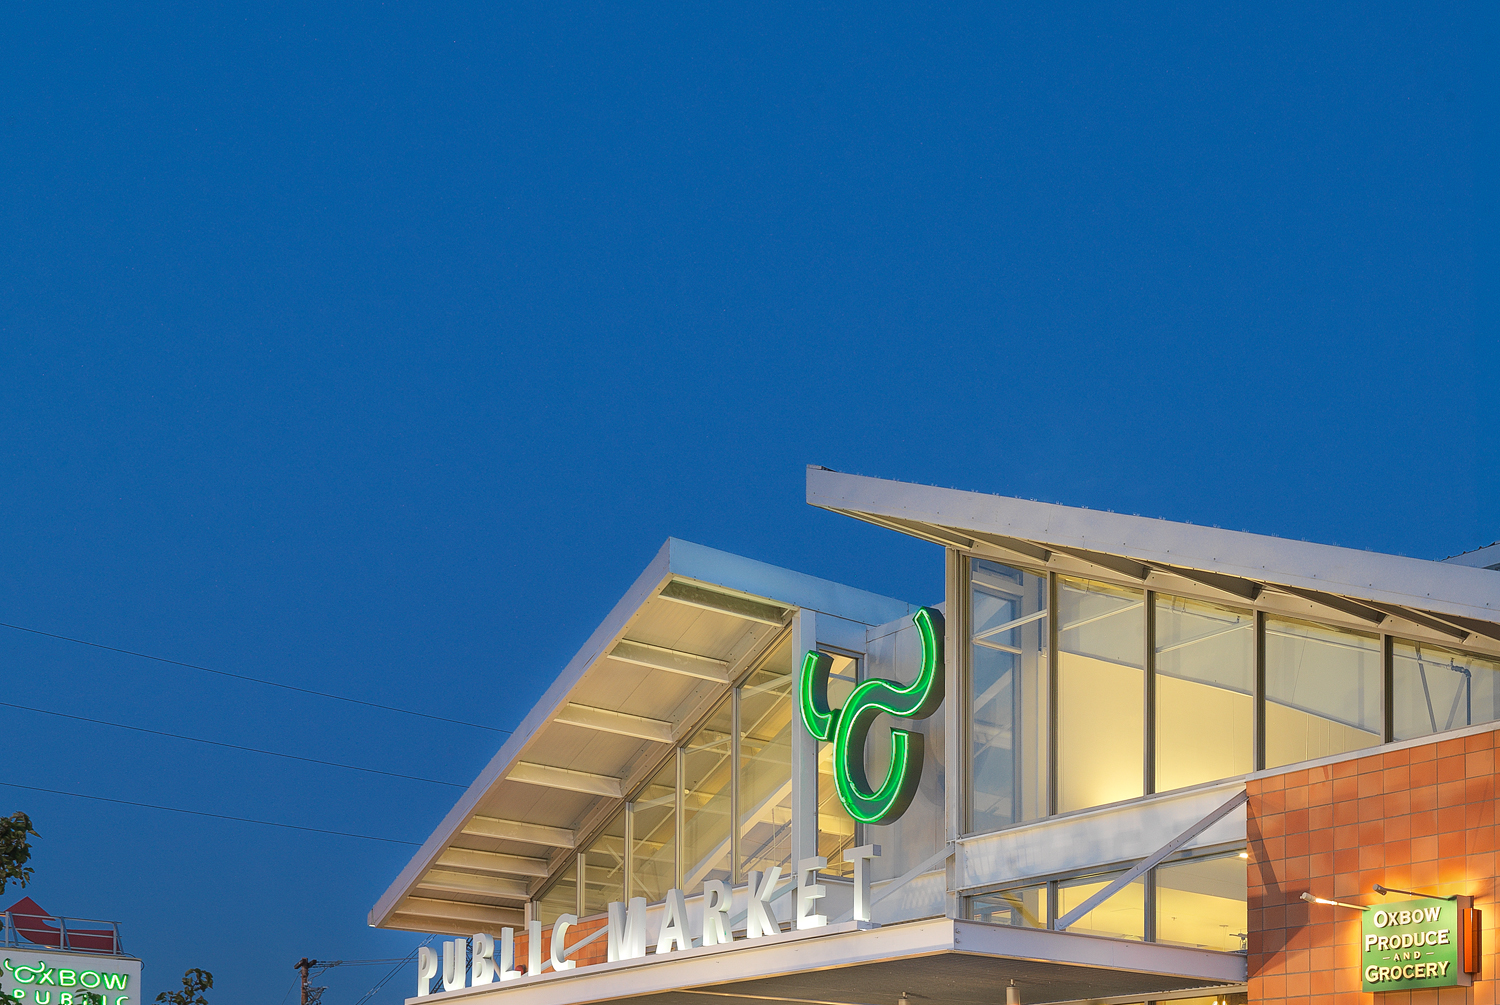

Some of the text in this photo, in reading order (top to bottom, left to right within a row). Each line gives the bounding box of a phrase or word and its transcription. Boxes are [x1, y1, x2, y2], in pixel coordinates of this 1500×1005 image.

[417, 843, 882, 998] PUBLIC MARKET
[1373, 906, 1441, 928] OXBOW
[1365, 929, 1450, 952] PRODUCE
[1393, 951, 1422, 962] AND
[4, 958, 129, 990] OXBOW
[1365, 961, 1450, 984] GROCERY
